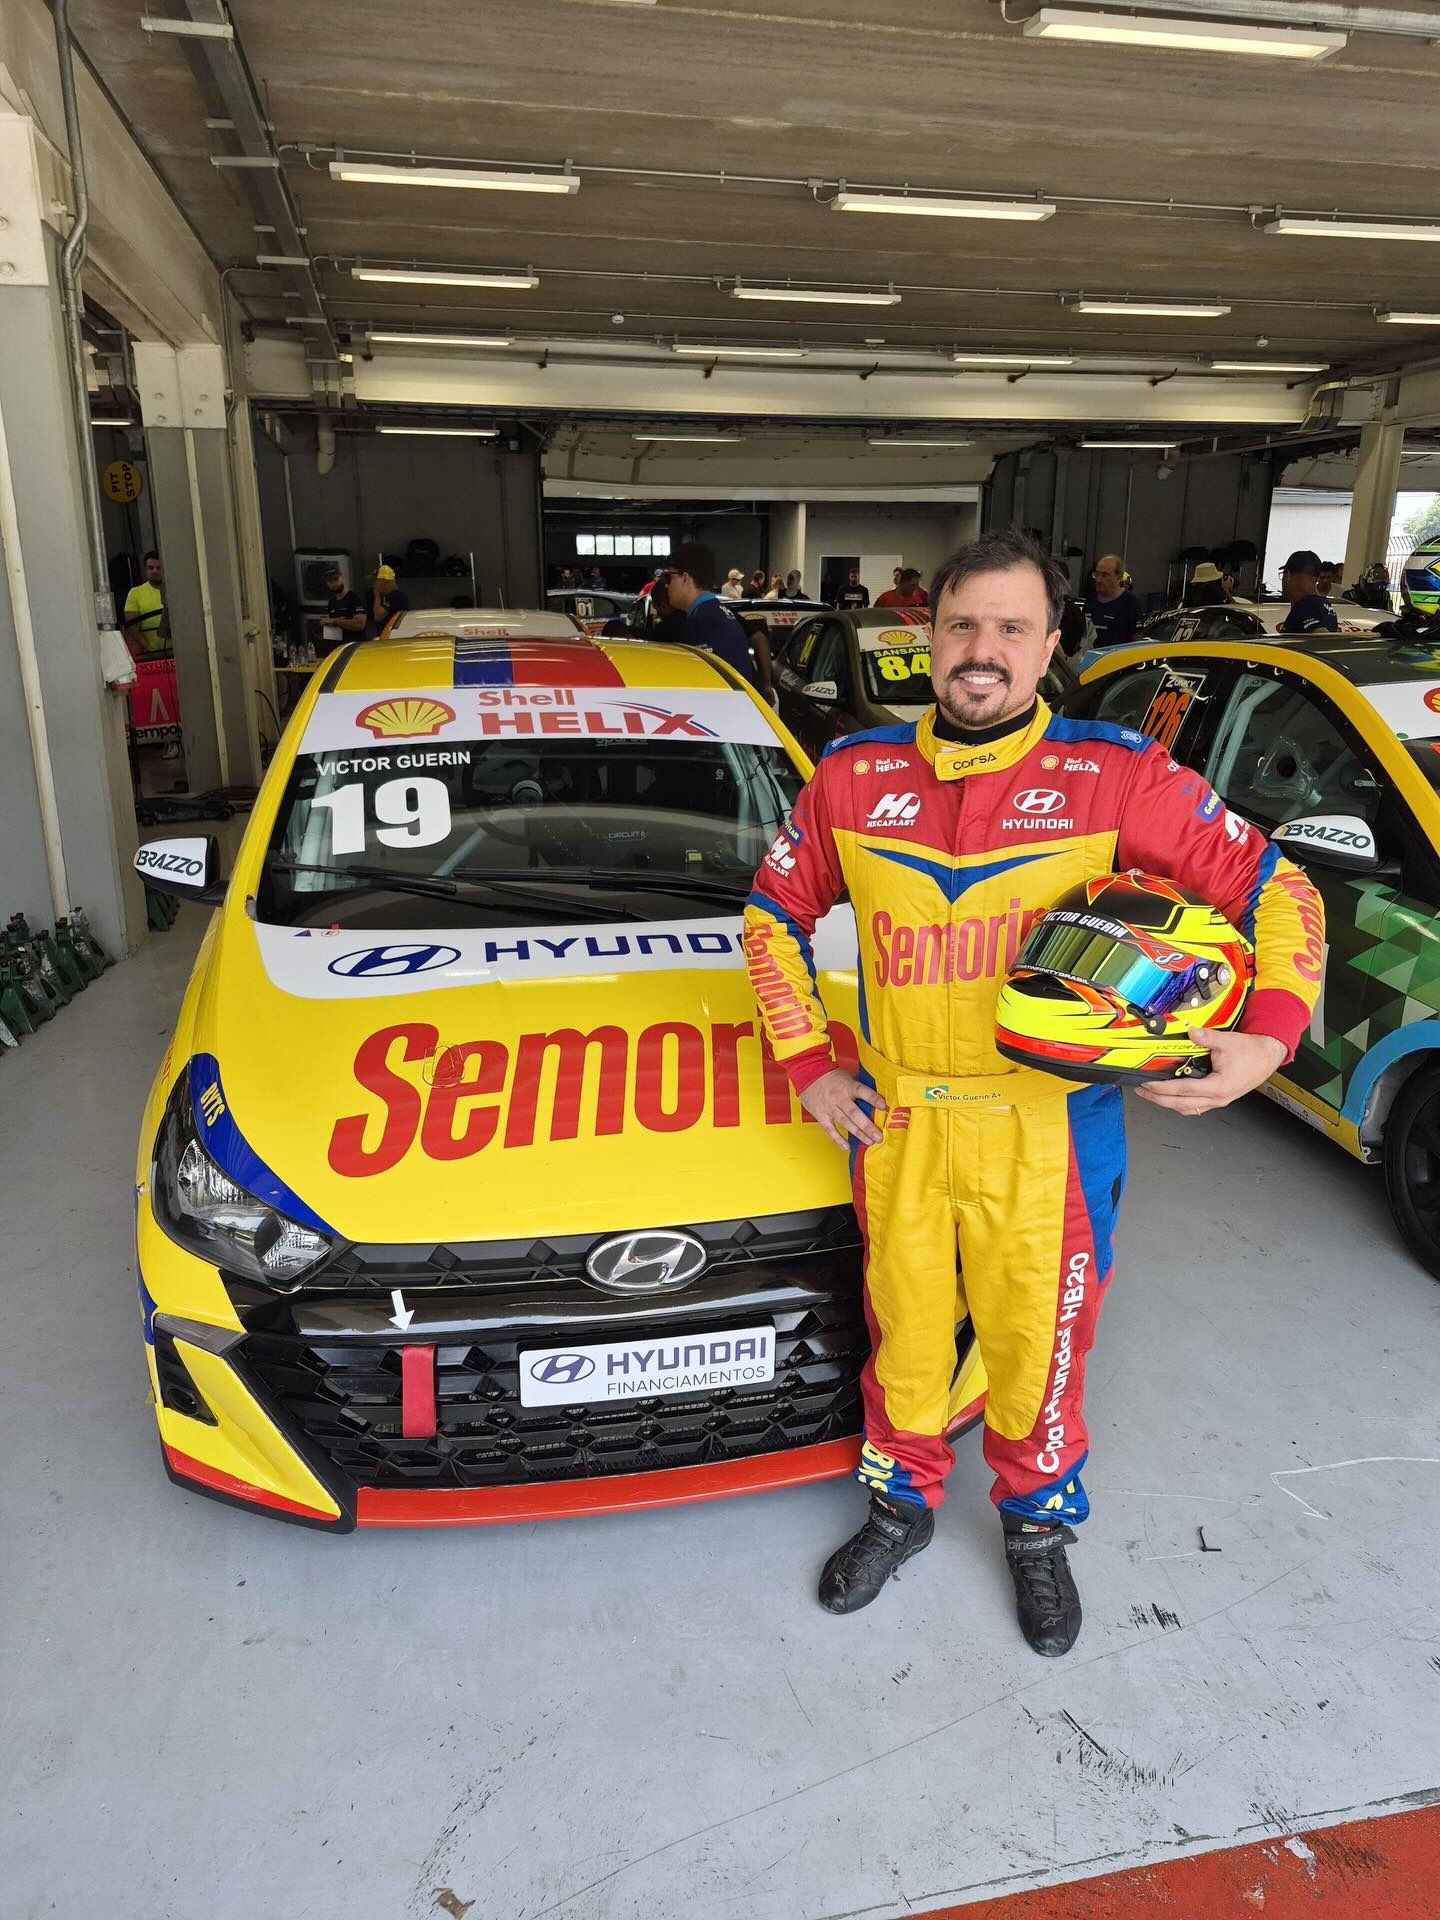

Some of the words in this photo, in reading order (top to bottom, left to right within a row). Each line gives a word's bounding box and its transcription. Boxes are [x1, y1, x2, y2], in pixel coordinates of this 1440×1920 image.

[110, 471, 121, 494] PIT
[122, 463, 136, 497] STOP
[463, 628, 508, 637] Shell
[877, 652, 931, 681] 84
[478, 689, 576, 706] Shell
[477, 710, 720, 737] HELIX
[1143, 691, 1193, 748] 126
[316, 756, 391, 777] VICTOR
[397, 751, 471, 769] GUERIN
[875, 760, 910, 772] HELIX
[1063, 760, 1100, 773] HELIX
[311, 776, 452, 856] 19
[1002, 818, 1073, 830] HYUNDAI
[1285, 824, 1371, 849] BRAZZO
[136, 849, 204, 876] BRAZZO
[1043, 911, 1082, 923] VICTOR
[1078, 914, 1129, 938] GUERIN
[485, 932, 745, 963] HYUND
[938, 1093, 960, 1101] Victor
[1060, 1251, 1090, 1323] HB20
[606, 1336, 766, 1376] HYUNDAI
[606, 1365, 766, 1395] FINANCIAMENTOS
